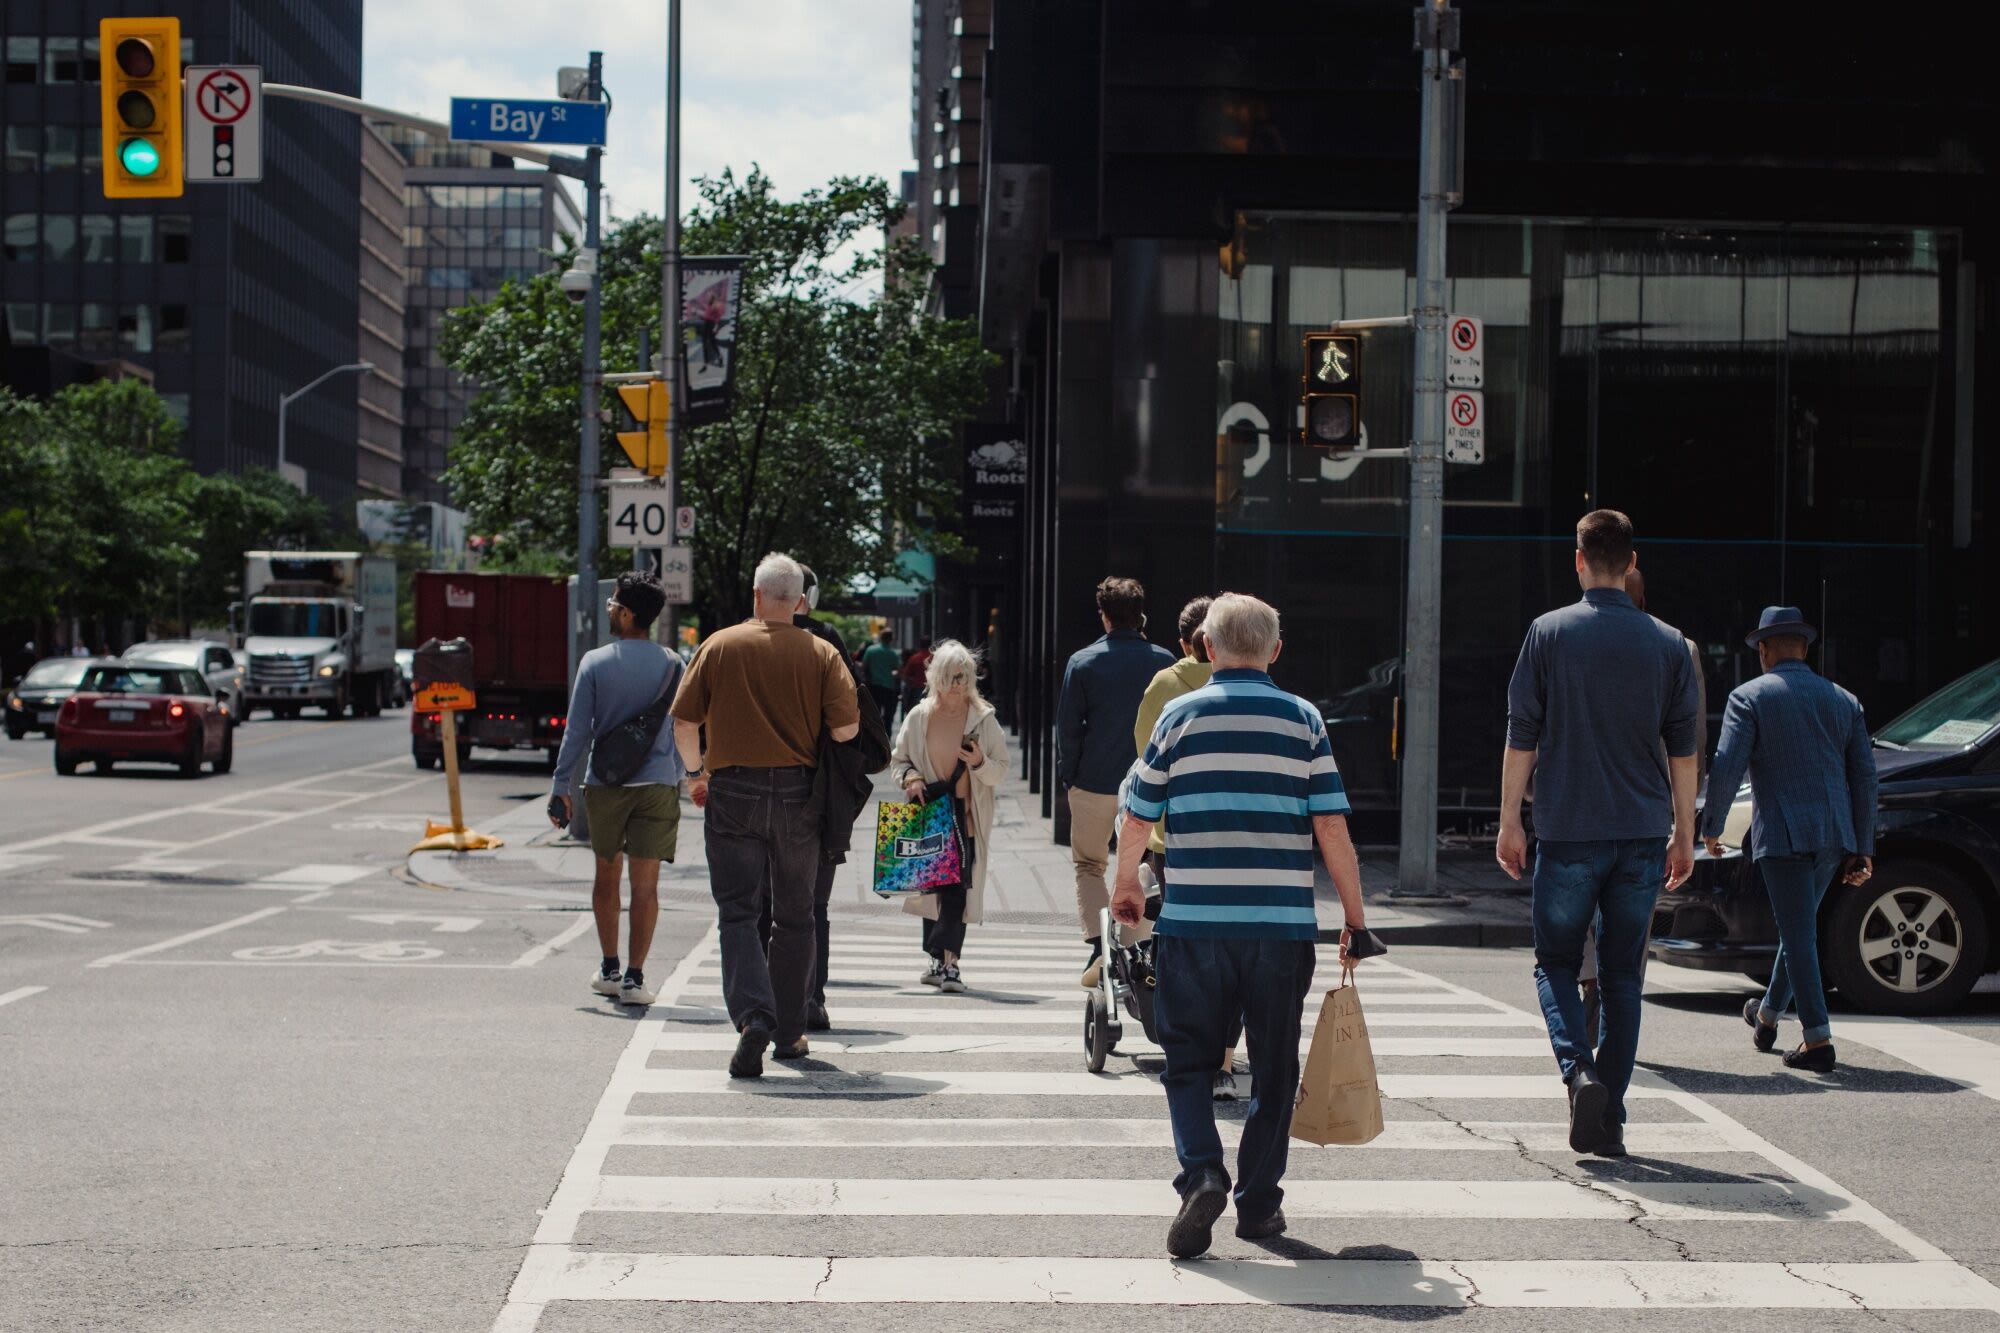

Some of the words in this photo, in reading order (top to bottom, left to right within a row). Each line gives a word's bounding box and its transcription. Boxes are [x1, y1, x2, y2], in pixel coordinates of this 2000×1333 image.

[490, 103, 545, 140] Bay
[551, 106, 567, 121] St
[1448, 427, 1456, 436] AT
[1459, 428, 1481, 438] OTHER
[1455, 439, 1474, 450] TIMES
[976, 470, 1026, 484] Roots
[615, 503, 665, 536] 40
[1336, 1026, 1352, 1043] IN
